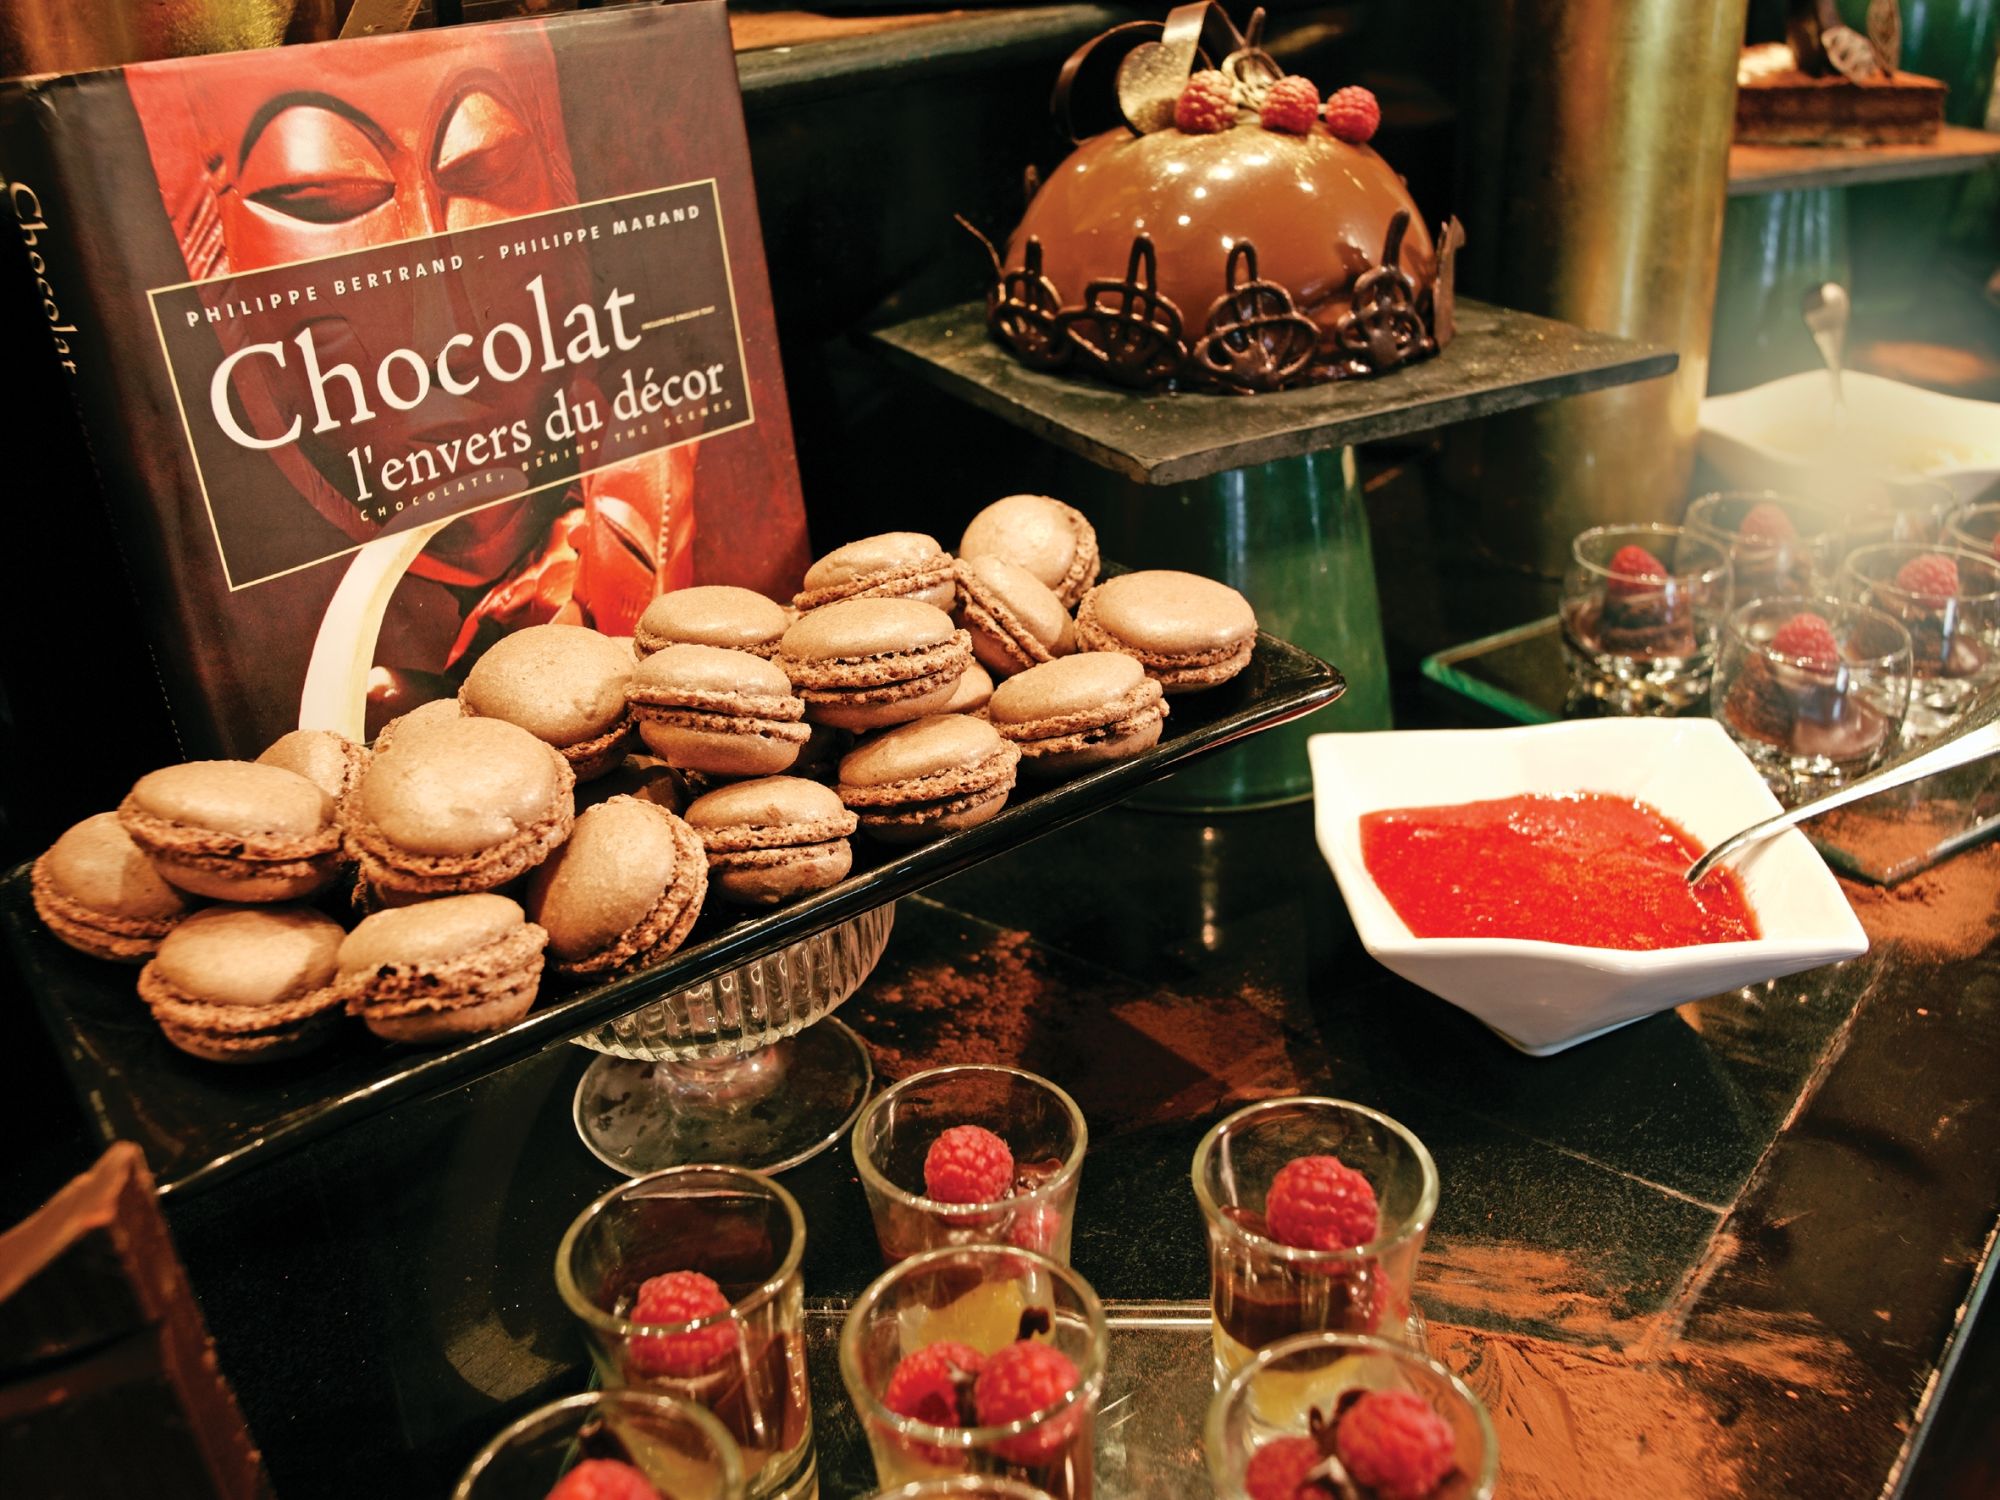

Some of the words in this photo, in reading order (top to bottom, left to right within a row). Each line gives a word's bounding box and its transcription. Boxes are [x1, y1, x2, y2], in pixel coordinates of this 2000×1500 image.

[9, 182, 78, 374] Chocolat
[186, 286, 317, 327] PHILIPPE
[334, 255, 464, 295] BERTRAND
[499, 226, 600, 259] PHILIPPE
[613, 205, 700, 235] MARAND
[210, 274, 642, 450] Chocolat
[348, 420, 532, 502] l'envers
[545, 388, 603, 442] du
[613, 363, 724, 421] décor
[360, 473, 504, 522] CHOCOLATE,
[521, 440, 599, 472] BEHIND
[614, 425, 648, 443] THE
[664, 400, 733, 428] SCENES
